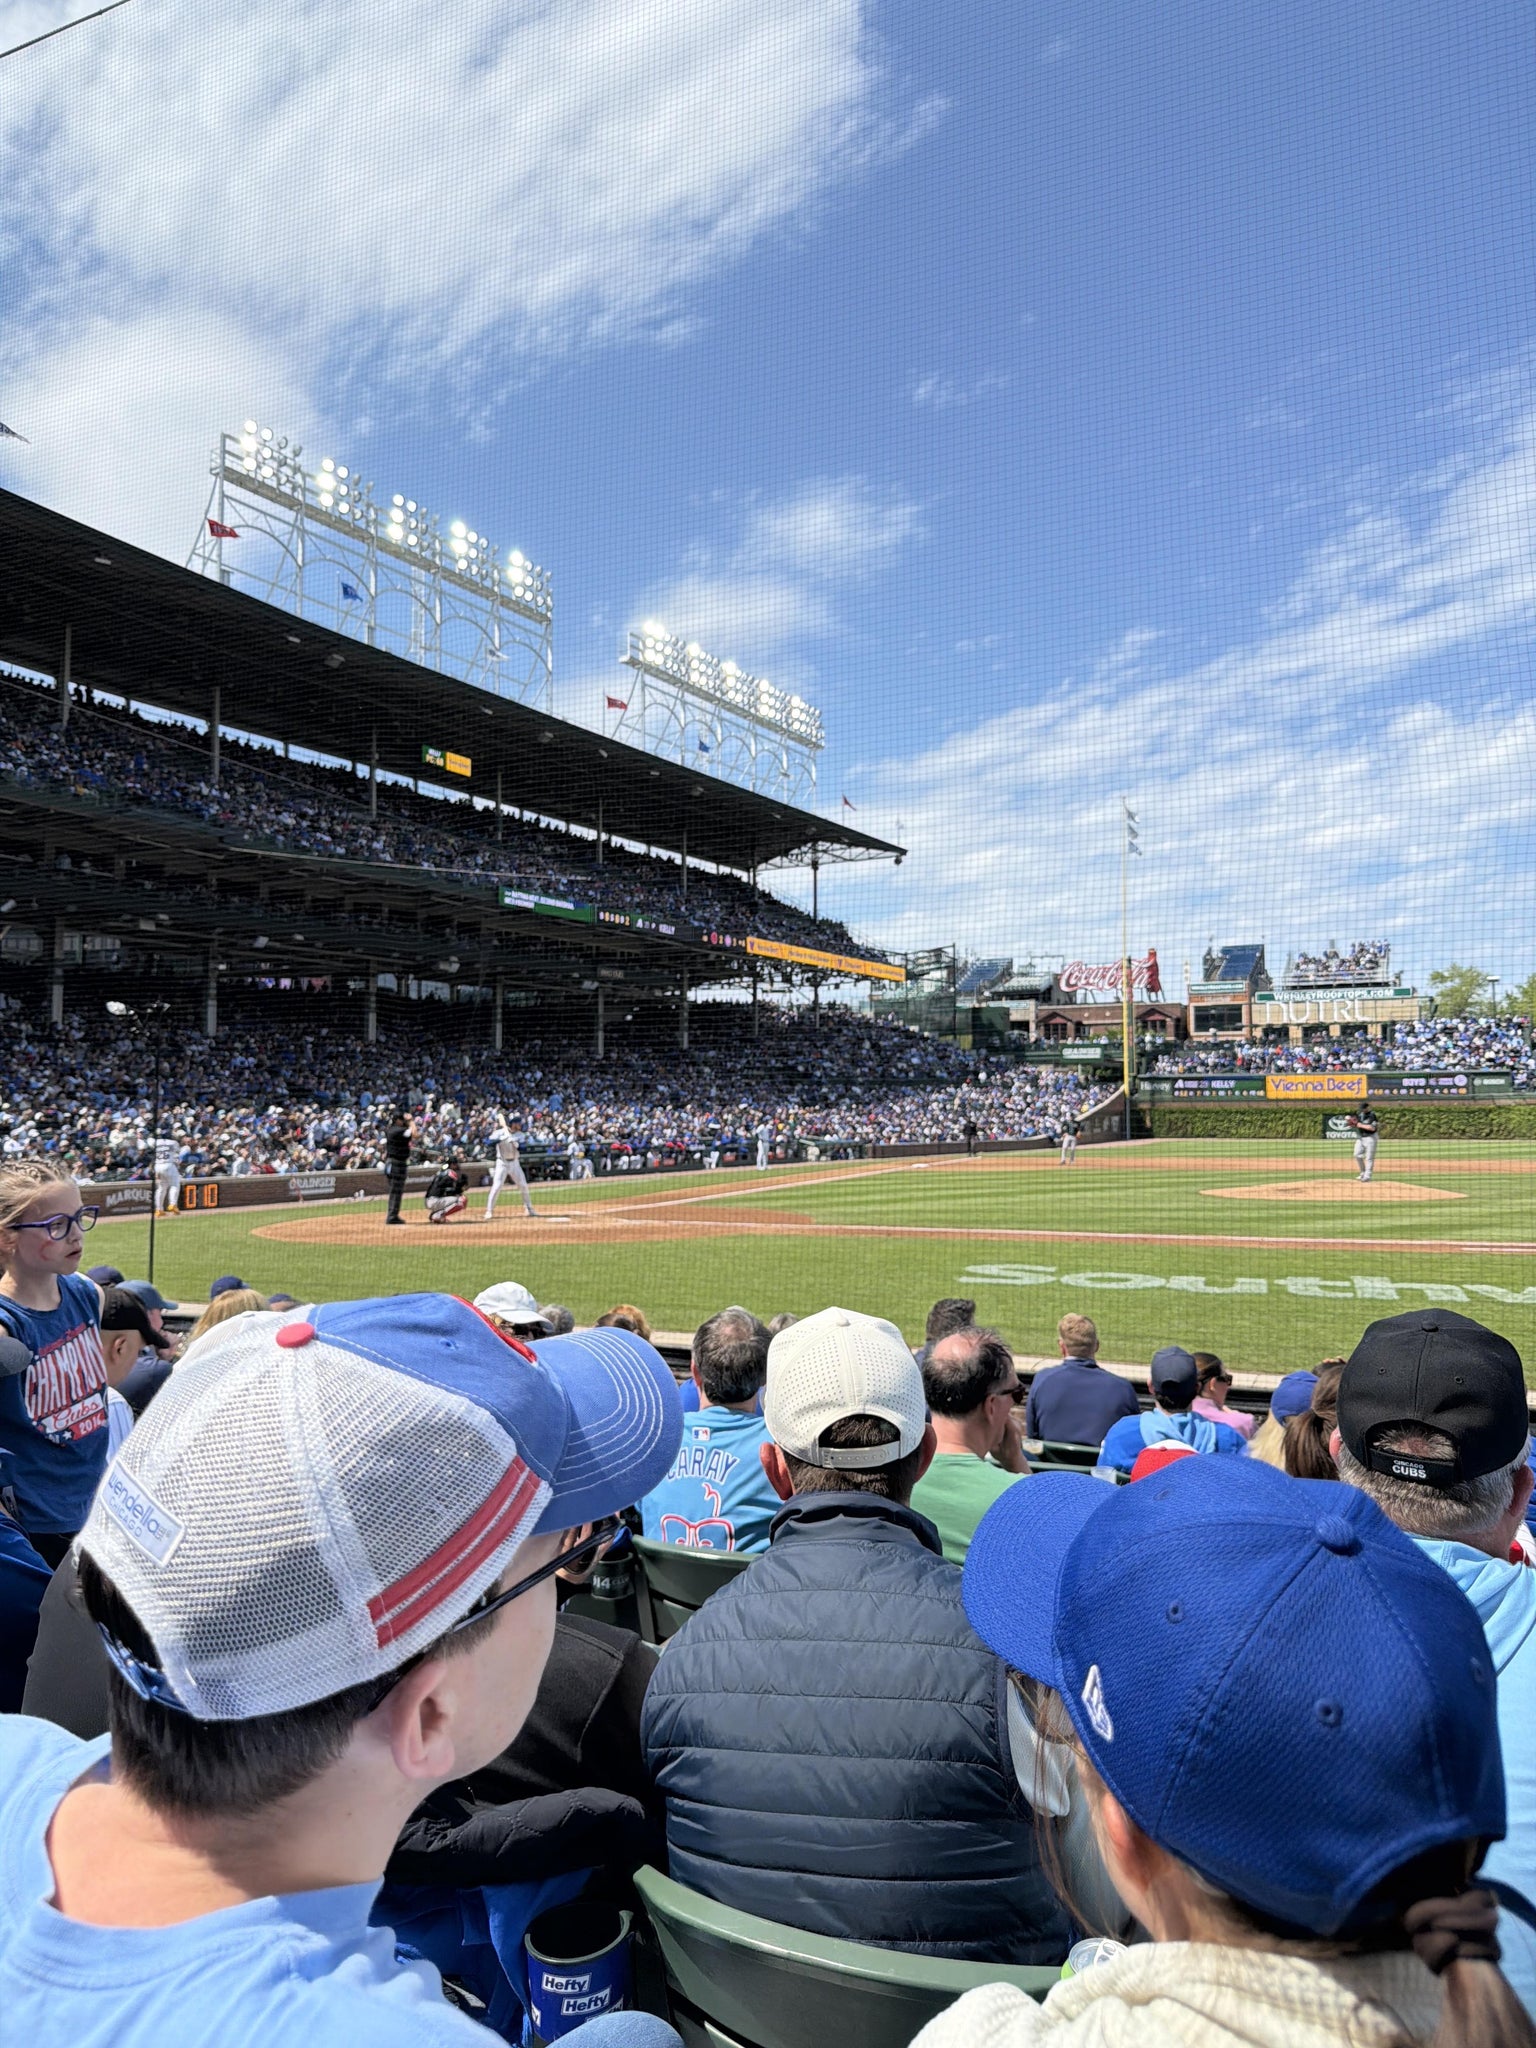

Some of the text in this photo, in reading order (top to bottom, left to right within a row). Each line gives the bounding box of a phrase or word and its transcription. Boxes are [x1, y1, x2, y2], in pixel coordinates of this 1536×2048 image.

[1060, 959, 1153, 992] Coca-Cla
[1271, 1079, 1324, 1091] Vienna
[1326, 1078, 1362, 1094] Beef
[1326, 1131, 1358, 1139] TOYOTA
[105, 1188, 153, 1208] MARQUE
[1392, 1465, 1427, 1479] CUBS
[544, 1976, 587, 1993] Hefty
[565, 1993, 608, 2012] Hefty
